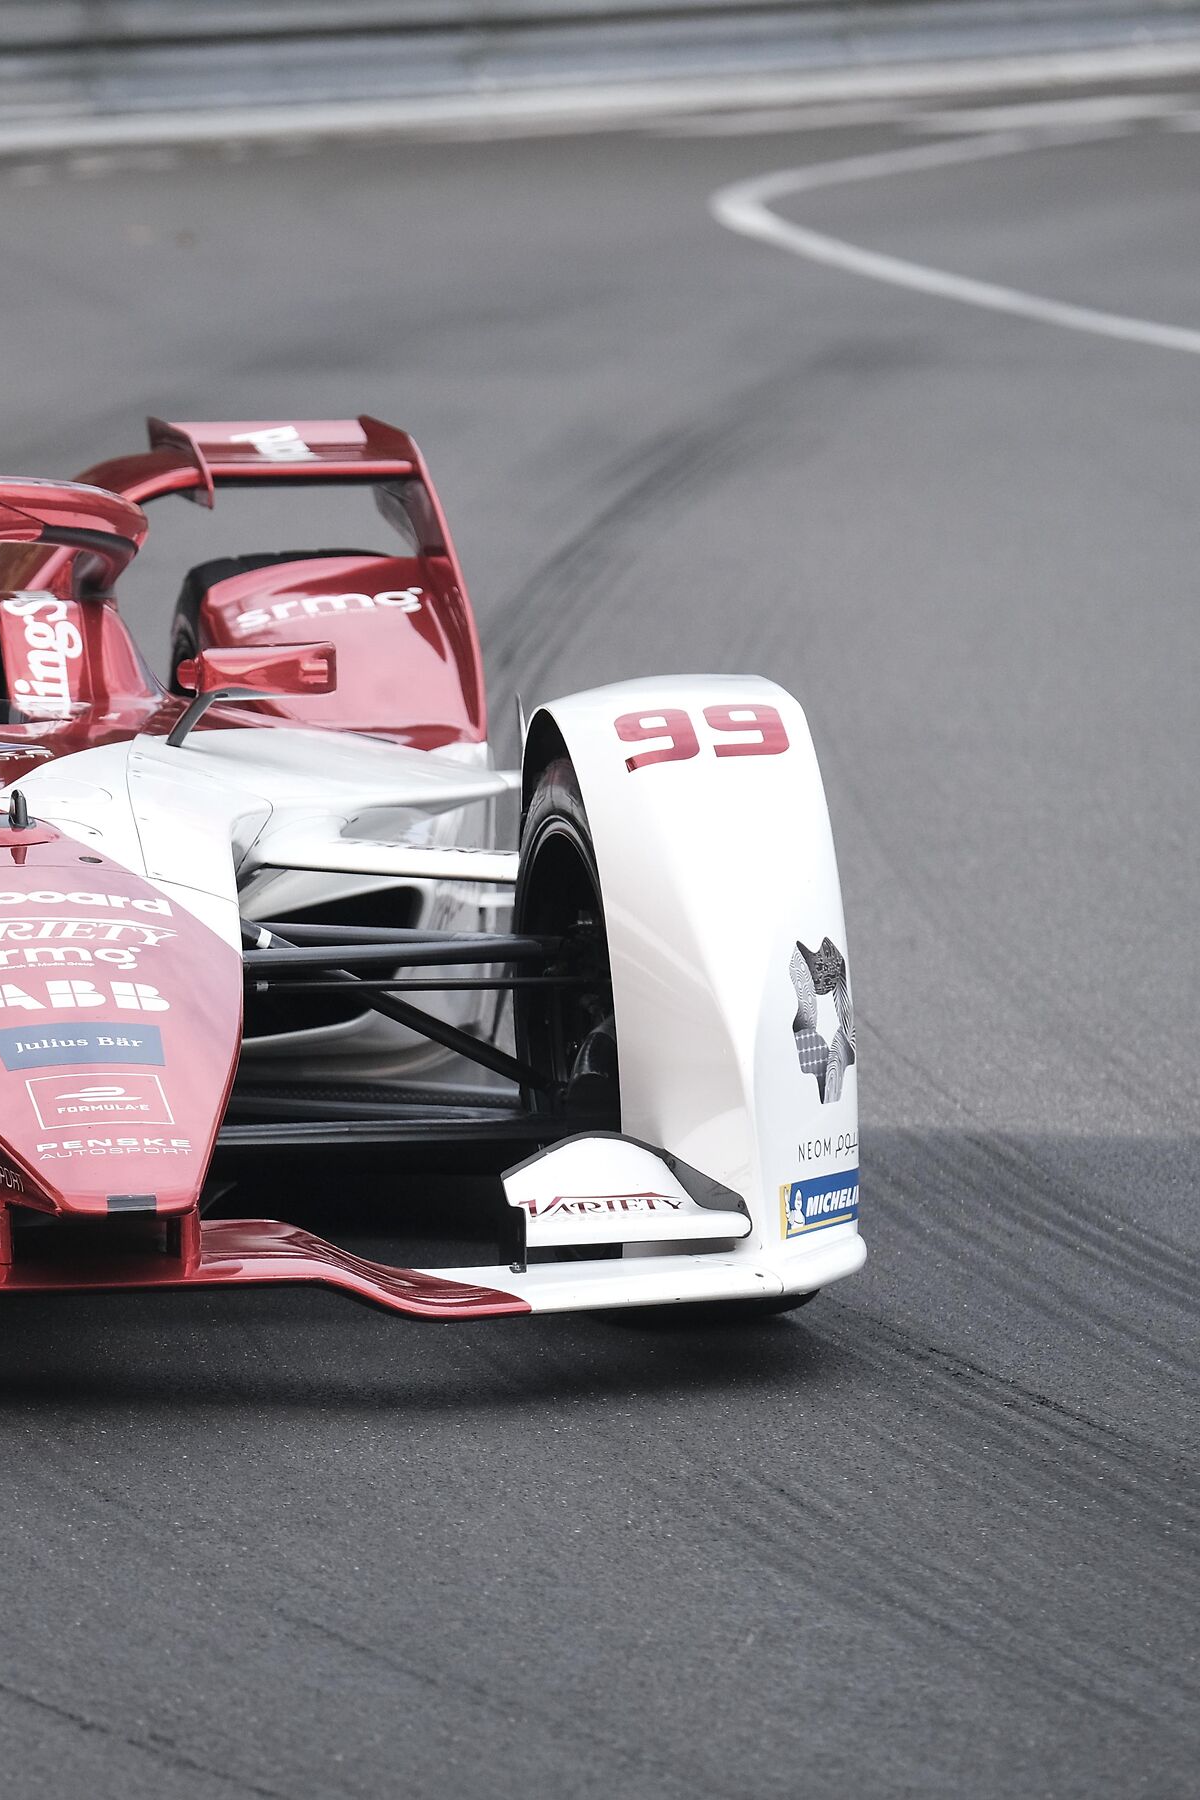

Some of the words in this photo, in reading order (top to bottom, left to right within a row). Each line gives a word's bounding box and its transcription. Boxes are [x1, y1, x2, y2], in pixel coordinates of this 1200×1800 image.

[236, 586, 424, 629] srmg
[613, 703, 790, 773] 99
[15, 1037, 89, 1053] Julius
[96, 1036, 144, 1048] Bär
[36, 1138, 192, 1152] PENSKE
[39, 1147, 193, 1160] AUTOSPORT
[798, 1137, 831, 1162] NEOM
[518, 1191, 683, 1218] VARIETY
